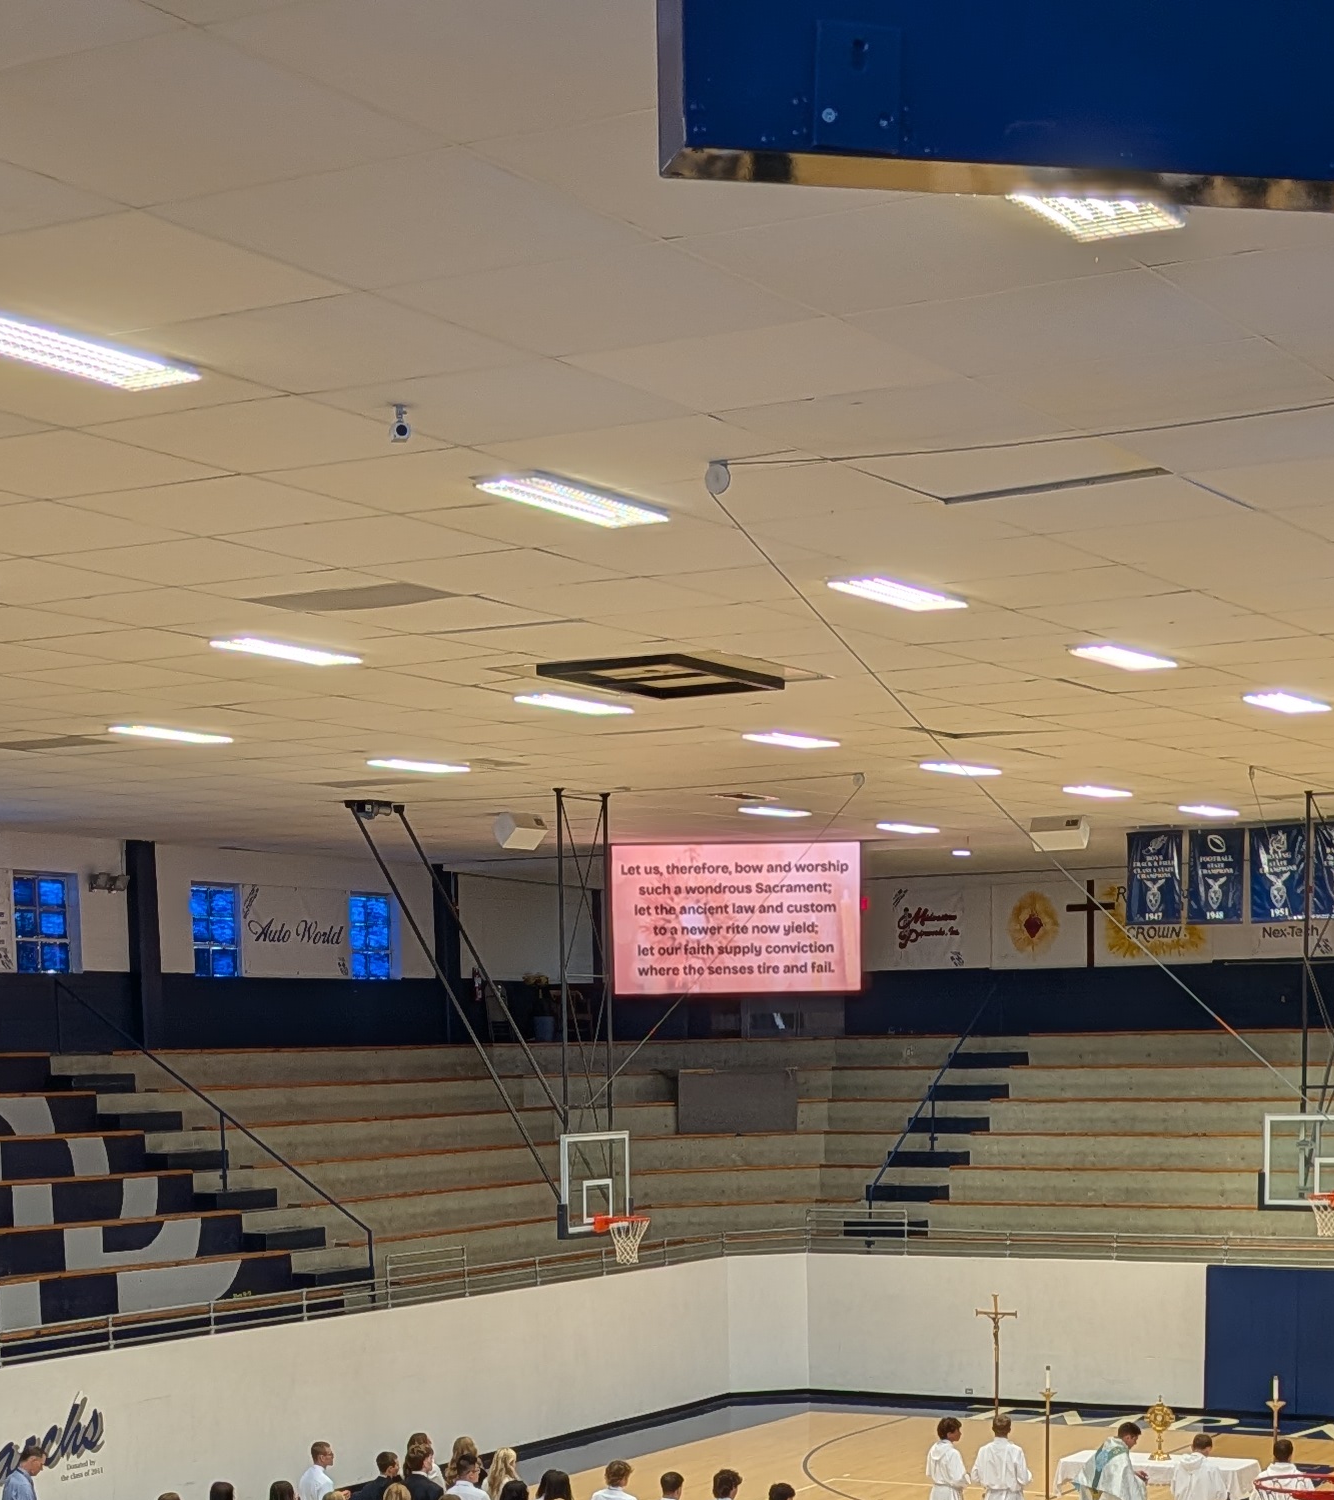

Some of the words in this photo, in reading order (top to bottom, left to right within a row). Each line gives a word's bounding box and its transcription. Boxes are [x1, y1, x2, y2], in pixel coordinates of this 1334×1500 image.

[1200, 855, 1234, 863] FOOTBALL
[621, 863, 641, 876] Let
[644, 866, 664, 877] us,
[666, 863, 732, 877] therefore,
[735, 861, 763, 873] bow
[767, 860, 792, 873] and
[794, 859, 849, 875] worship
[639, 883, 671, 895] such
[674, 886, 682, 895] a
[685, 882, 752, 895] wondrous
[755, 881, 832, 895] Sacrament;
[634, 904, 652, 916] let
[655, 904, 676, 916] the
[679, 903, 730, 915] ancient
[732, 902, 755, 914] law
[759, 901, 784, 914] and
[786, 902, 836, 914] custom
[1207, 911, 1224, 920] 1948
[1270, 908, 1289, 917] 1951
[1145, 912, 1163, 921] 1947
[248, 918, 291, 943] Auto
[296, 920, 344, 945] World
[653, 925, 667, 936] to
[670, 927, 678, 936] a
[681, 926, 723, 936] newer
[725, 923, 748, 935] rite
[751, 924, 780, 934] now
[783, 922, 819, 936] yield;
[1262, 925, 1319, 939] Nex-Teh
[638, 945, 655, 957] let
[658, 946, 681, 956] our
[683, 943, 714, 956] faith
[717, 943, 762, 957] supply
[765, 942, 835, 955] conviction
[638, 965, 680, 977] where
[682, 964, 705, 976] the
[707, 965, 754, 976] senses
[757, 963, 780, 975] tire
[783, 962, 808, 974] and
[811, 961, 835, 974] fail.
[67, 1460, 88, 1470] Donated
[70, 1472, 83, 1480] class
